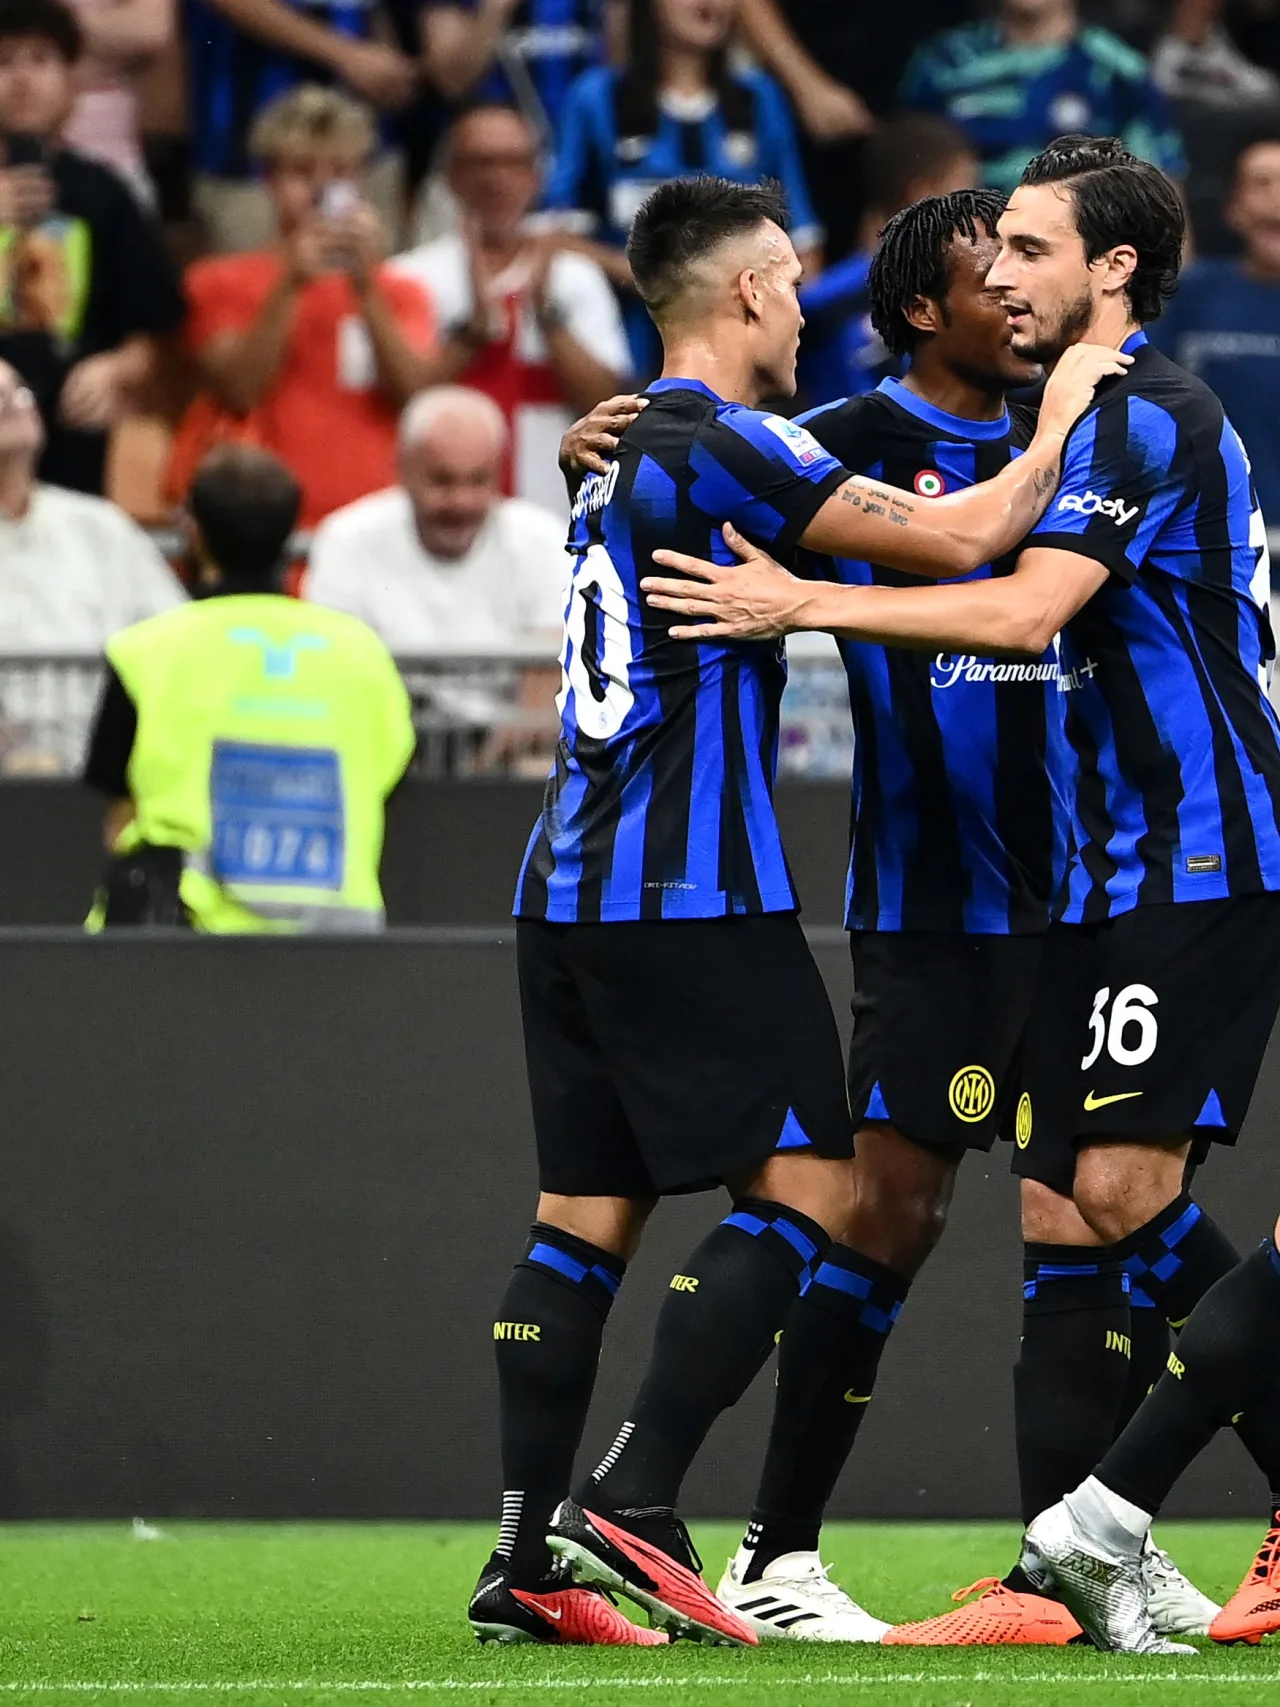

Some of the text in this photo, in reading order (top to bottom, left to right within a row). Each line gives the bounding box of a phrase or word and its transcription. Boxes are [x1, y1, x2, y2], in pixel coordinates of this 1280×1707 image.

[1057, 490, 1140, 526] ebay
[930, 652, 1060, 689] Paramoun
[1080, 983, 1160, 1071] 36
[493, 1321, 541, 1342] NTER
